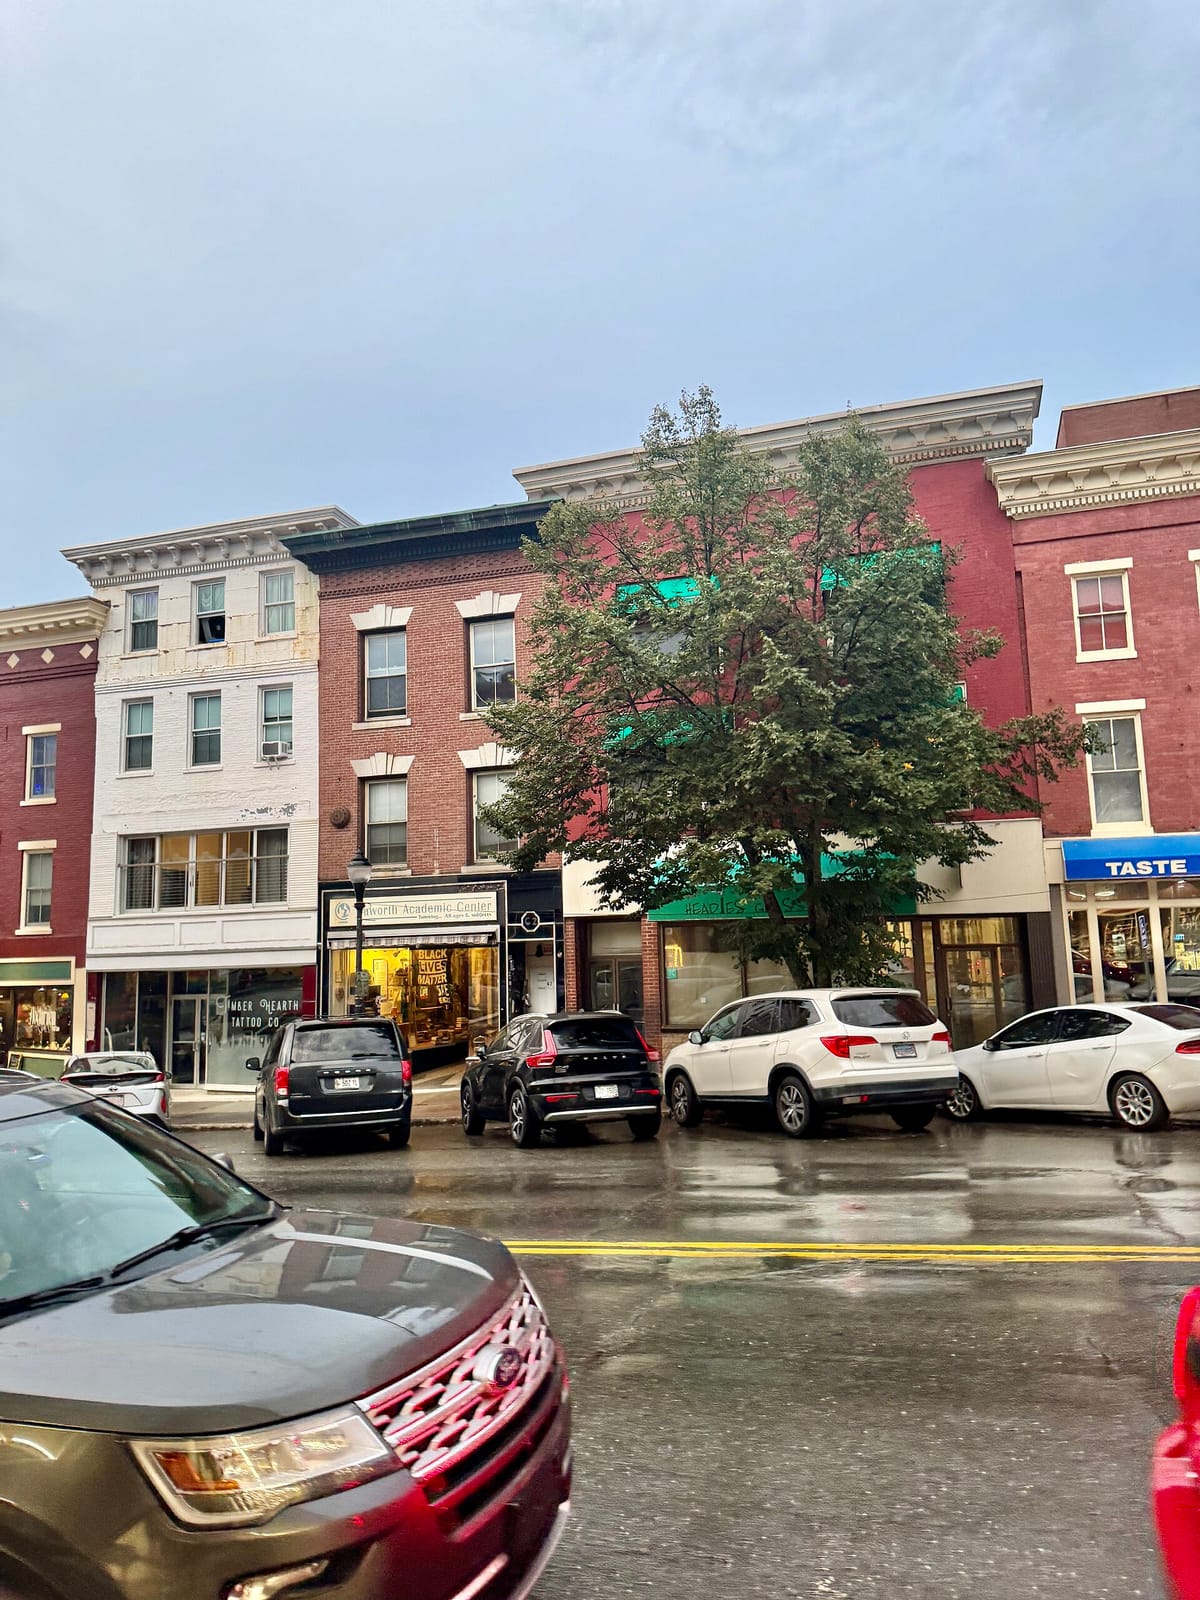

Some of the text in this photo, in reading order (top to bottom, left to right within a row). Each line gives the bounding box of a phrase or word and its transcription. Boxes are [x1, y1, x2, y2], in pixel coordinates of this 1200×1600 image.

[1105, 859, 1187, 876] TASTE
[363, 901, 492, 917] aworth Academic Center
[685, 898, 745, 914] HEADIES
[418, 949, 448, 959] BLACK
[419, 960, 447, 973] LIVES
[417, 973, 448, 985] MATTER
[260, 999, 299, 1014] HEARTH
[231, 1016, 279, 1028] TATTOO CO
